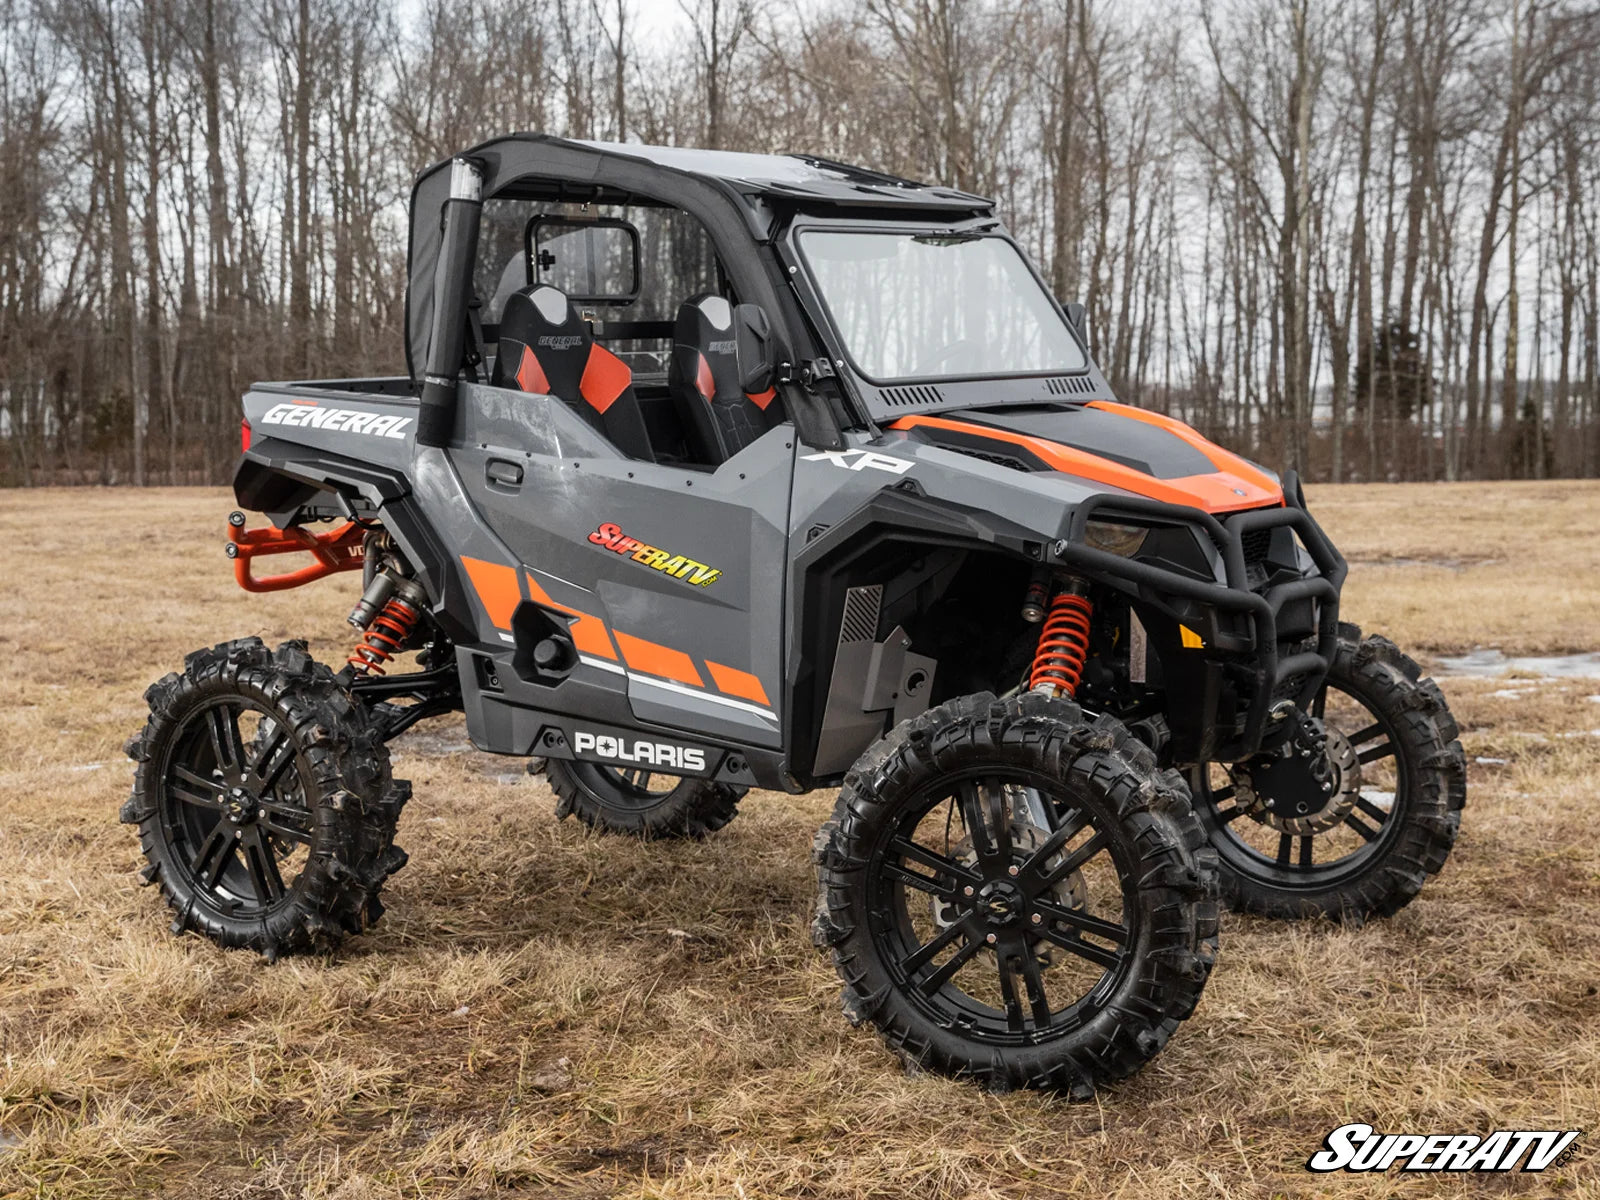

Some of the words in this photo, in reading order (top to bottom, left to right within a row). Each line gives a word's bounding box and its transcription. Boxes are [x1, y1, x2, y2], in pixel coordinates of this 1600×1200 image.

[538, 335, 583, 346] GENERAL
[261, 403, 413, 440] GENERAL
[800, 449, 916, 475] XP
[588, 522, 721, 586] SUPERATV
[575, 731, 706, 772] POLARIS
